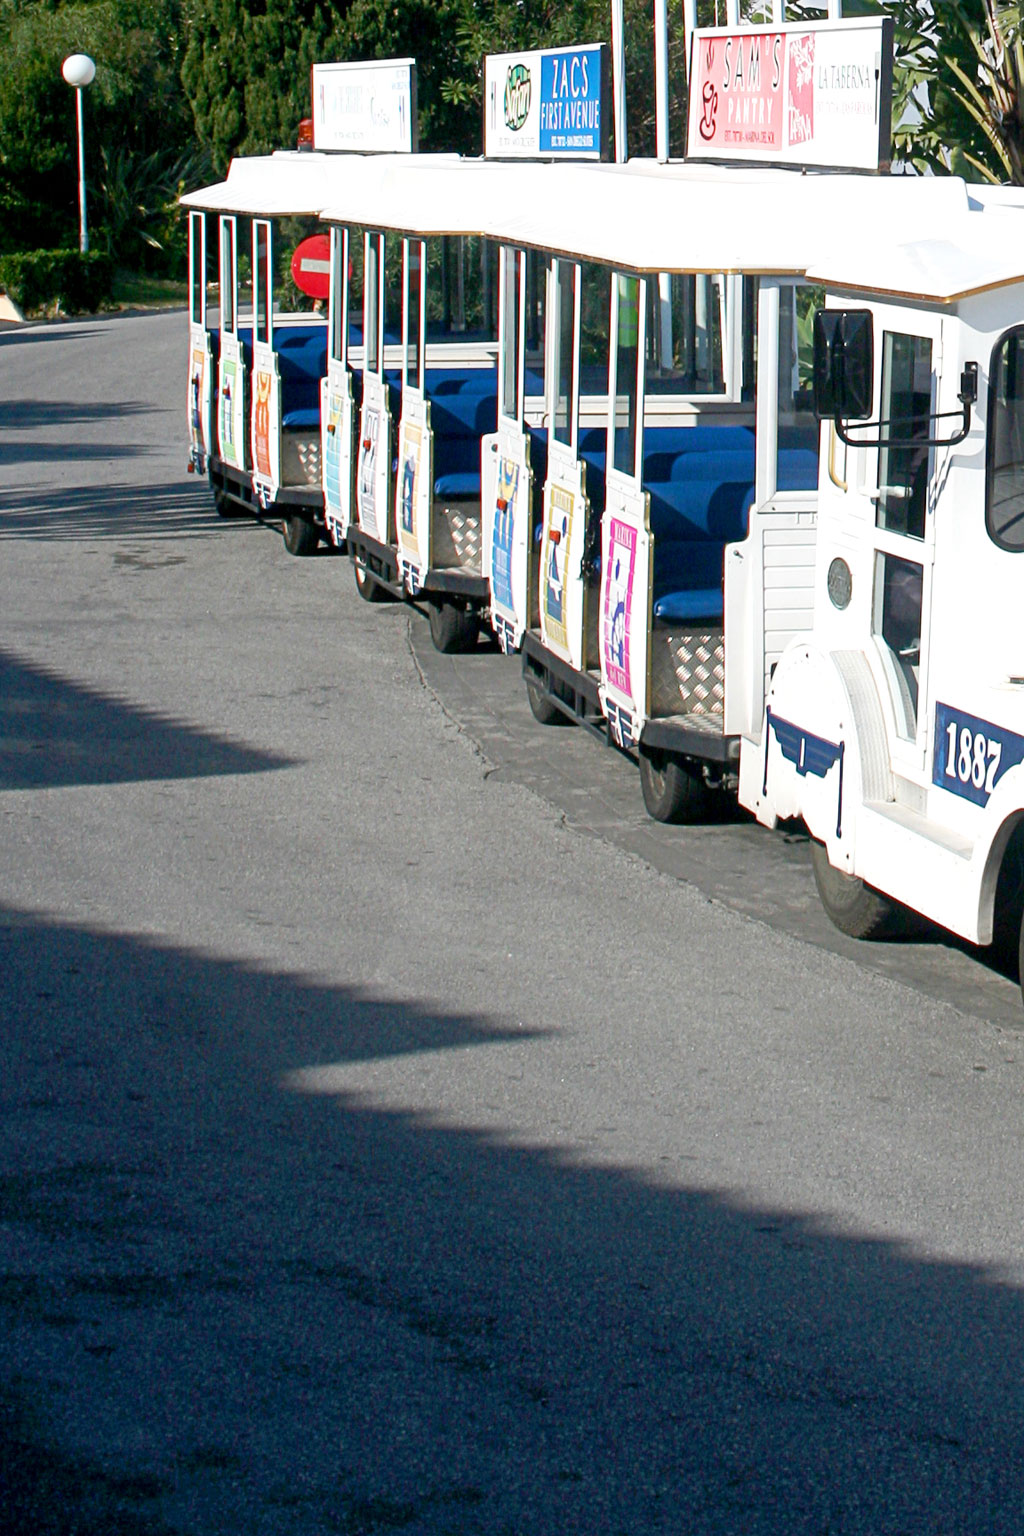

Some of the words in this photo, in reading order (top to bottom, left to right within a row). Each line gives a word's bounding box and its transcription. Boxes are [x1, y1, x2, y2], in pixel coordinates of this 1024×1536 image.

[552, 55, 588, 99] ZACS
[723, 34, 781, 93] SAM'S
[818, 64, 828, 89] LA
[830, 64, 871, 89] TABERNA
[541, 101, 563, 130] FIRST
[563, 99, 600, 130] AVENUE
[728, 97, 773, 124] PANTRY
[945, 721, 1002, 794] 1887
